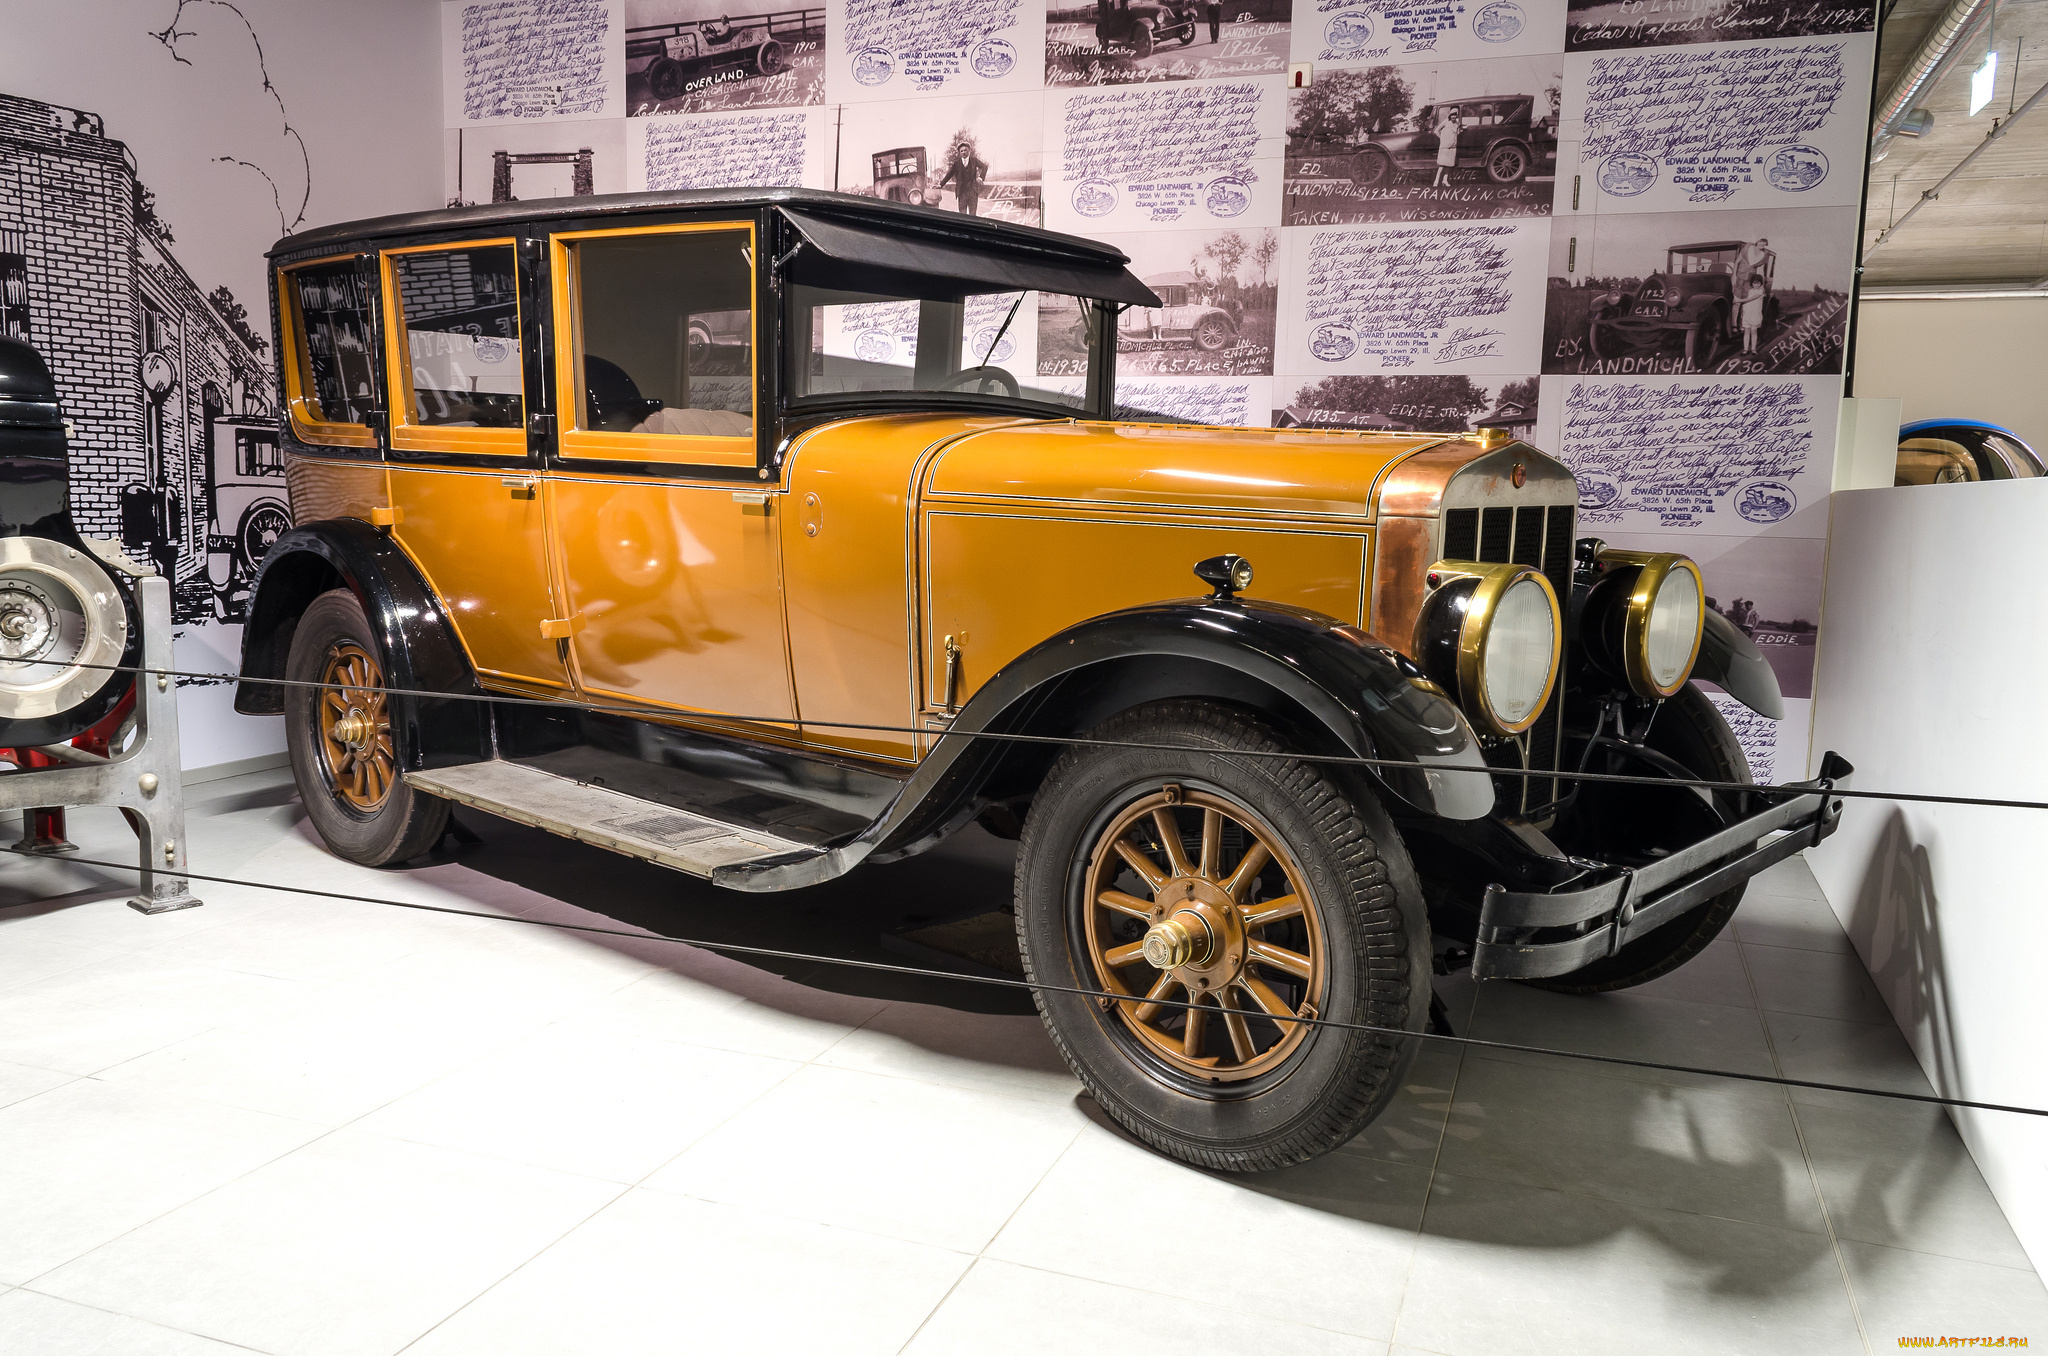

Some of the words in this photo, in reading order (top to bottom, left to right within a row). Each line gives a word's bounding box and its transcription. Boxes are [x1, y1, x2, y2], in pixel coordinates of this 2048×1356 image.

[1236, 12, 1254, 22] ED.
[1384, 11, 1412, 19] EDWARD
[1410, 32, 1437, 40] PIONEER
[1572, 22, 1629, 44] Cedar
[674, 34, 690, 46] 348
[794, 42, 816, 54] 1910
[1688, 50, 1716, 62] and
[1666, 157, 1699, 165] EDWARD
[1703, 156, 1751, 165] LANDMICHL,
[1754, 156, 1763, 164] JR
[1299, 163, 1322, 174] ED.
[1712, 165, 1728, 173] 65th
[1673, 175, 1702, 183] Chicago
[1728, 175, 1740, 183] 29,
[1497, 185, 1534, 198] CAR.
[1695, 184, 1729, 192] PIONEER
[1402, 207, 1484, 220] WISCONSIN.
[1640, 288, 1665, 300] 1923
[1635, 306, 1663, 316] CAR.
[1388, 331, 1427, 339] LANDMICHL,
[1556, 336, 1582, 358] BY.
[1578, 353, 1702, 374] LANDMICHL.
[1348, 415, 1370, 425] AT.
[1631, 488, 1663, 496] EDWARD
[1666, 488, 1711, 497] LANDMICHL,
[1715, 489, 1725, 497] JR
[1756, 634, 1798, 645] EDDIE
[1768, 720, 1777, 728] 6
[1115, 752, 1195, 777] INDIA
[1231, 771, 1338, 909] BALLOON
